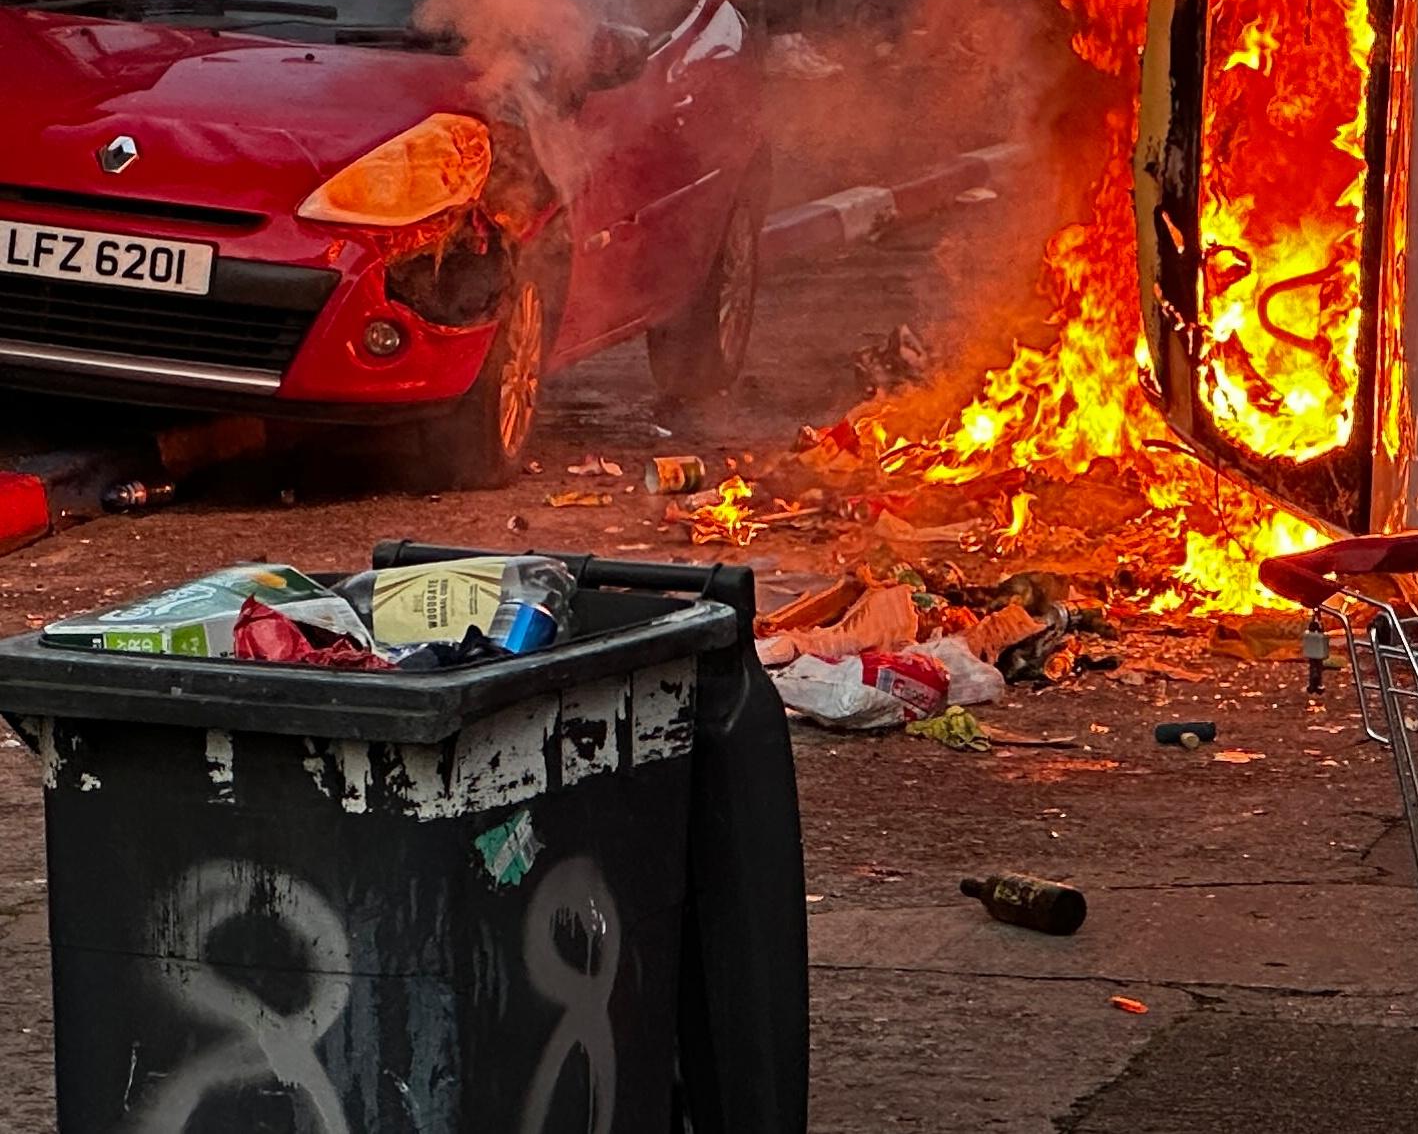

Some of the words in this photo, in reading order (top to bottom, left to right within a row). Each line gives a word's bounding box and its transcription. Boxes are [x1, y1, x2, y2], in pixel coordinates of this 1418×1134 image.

[7, 228, 85, 274] LFZ
[95, 240, 186, 285] 6201
[427, 578, 439, 629] WOODGATE
